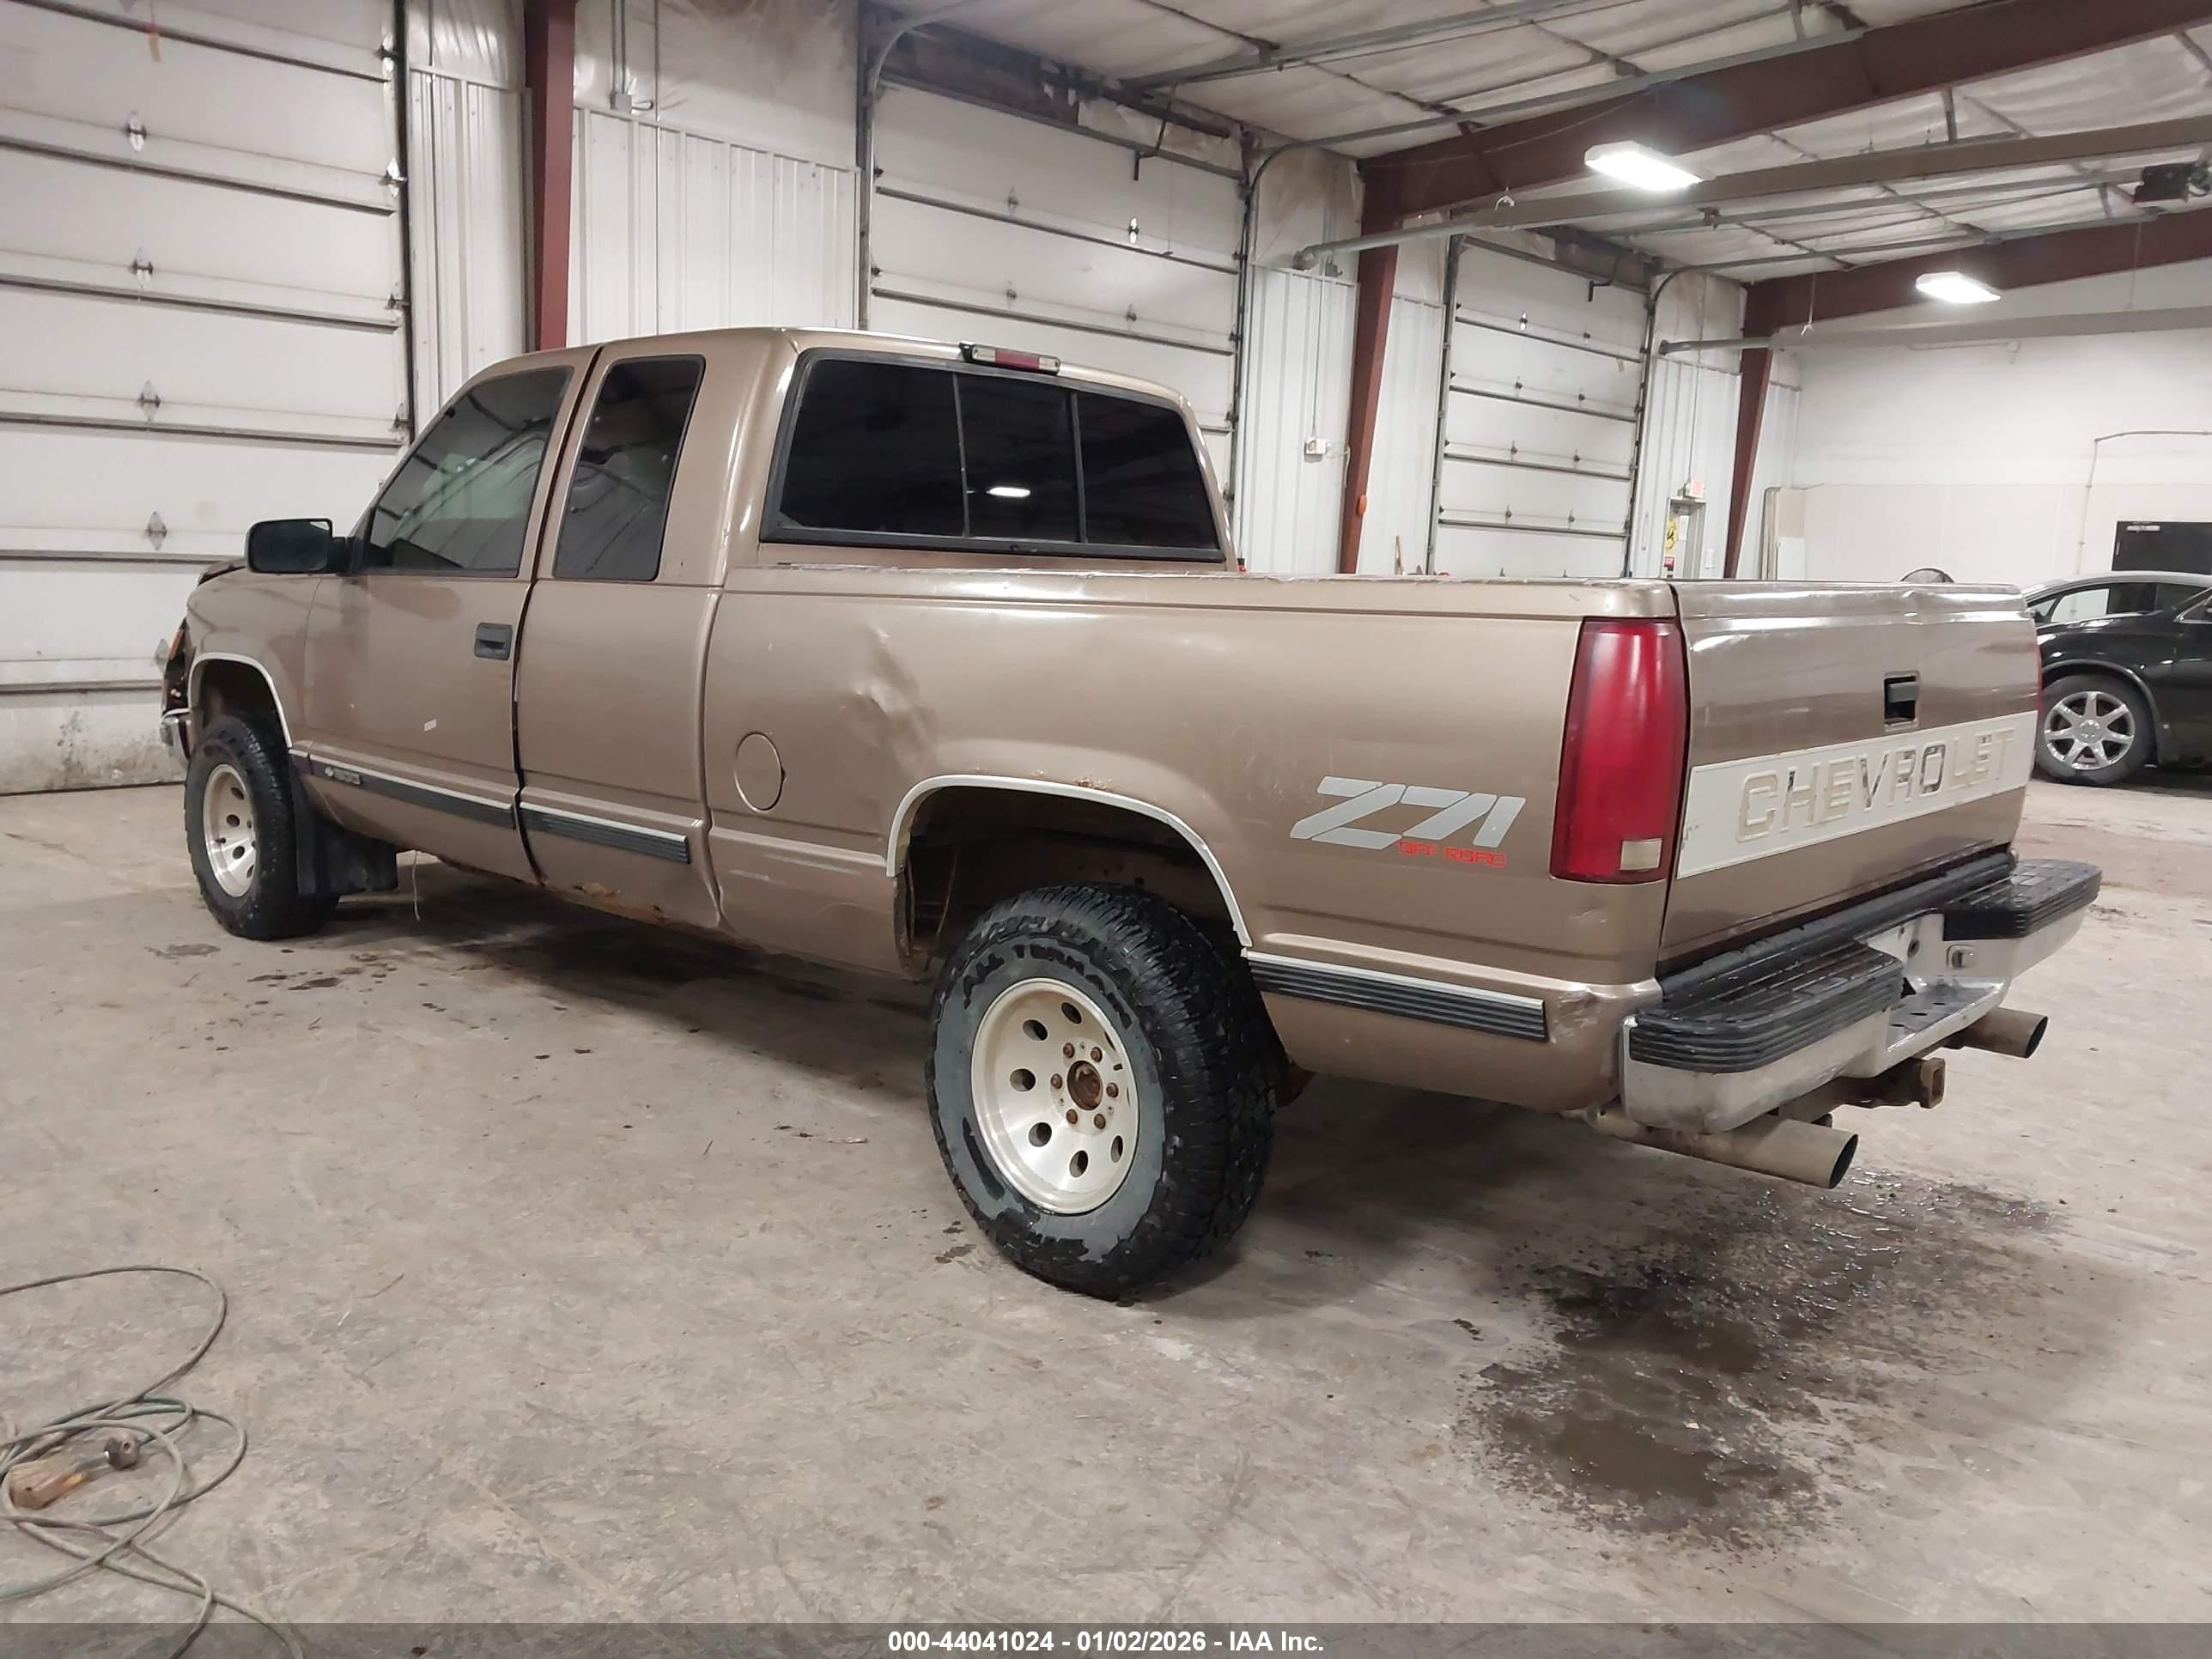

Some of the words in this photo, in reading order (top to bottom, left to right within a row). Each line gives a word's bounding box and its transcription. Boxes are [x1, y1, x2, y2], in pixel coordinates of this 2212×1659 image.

[1290, 775, 1526, 850] Z71
[1738, 727, 2014, 842] CHEVROLET
[1399, 841, 1439, 855] OFF
[1444, 848, 1505, 866] ROAD
